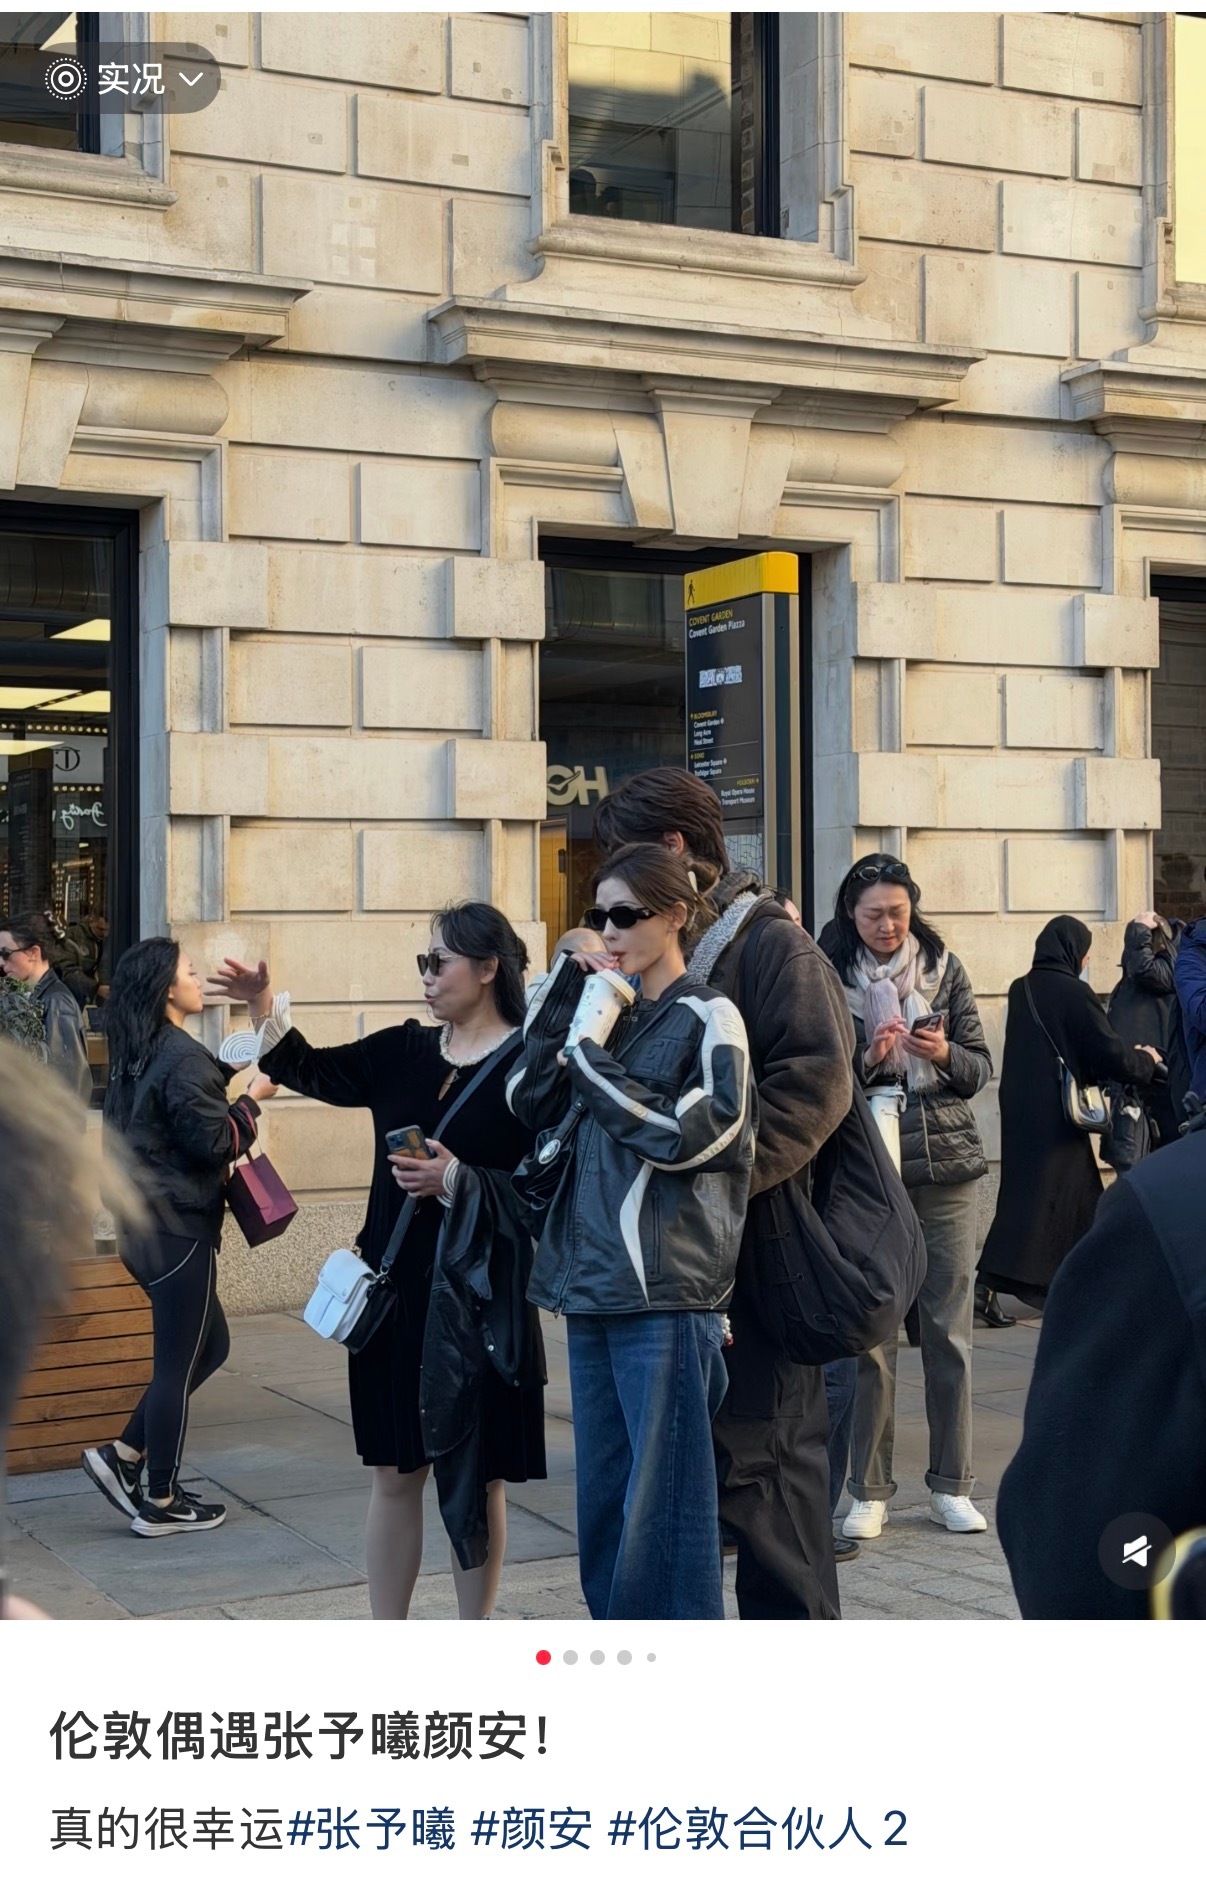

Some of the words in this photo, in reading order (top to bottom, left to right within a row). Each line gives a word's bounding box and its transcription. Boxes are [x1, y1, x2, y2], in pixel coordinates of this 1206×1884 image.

[689, 614, 710, 627] COVENT
[711, 609, 733, 622] GARDEN
[689, 627, 708, 639] Covent
[708, 623, 727, 634] Garden
[728, 619, 745, 630] Piazza
